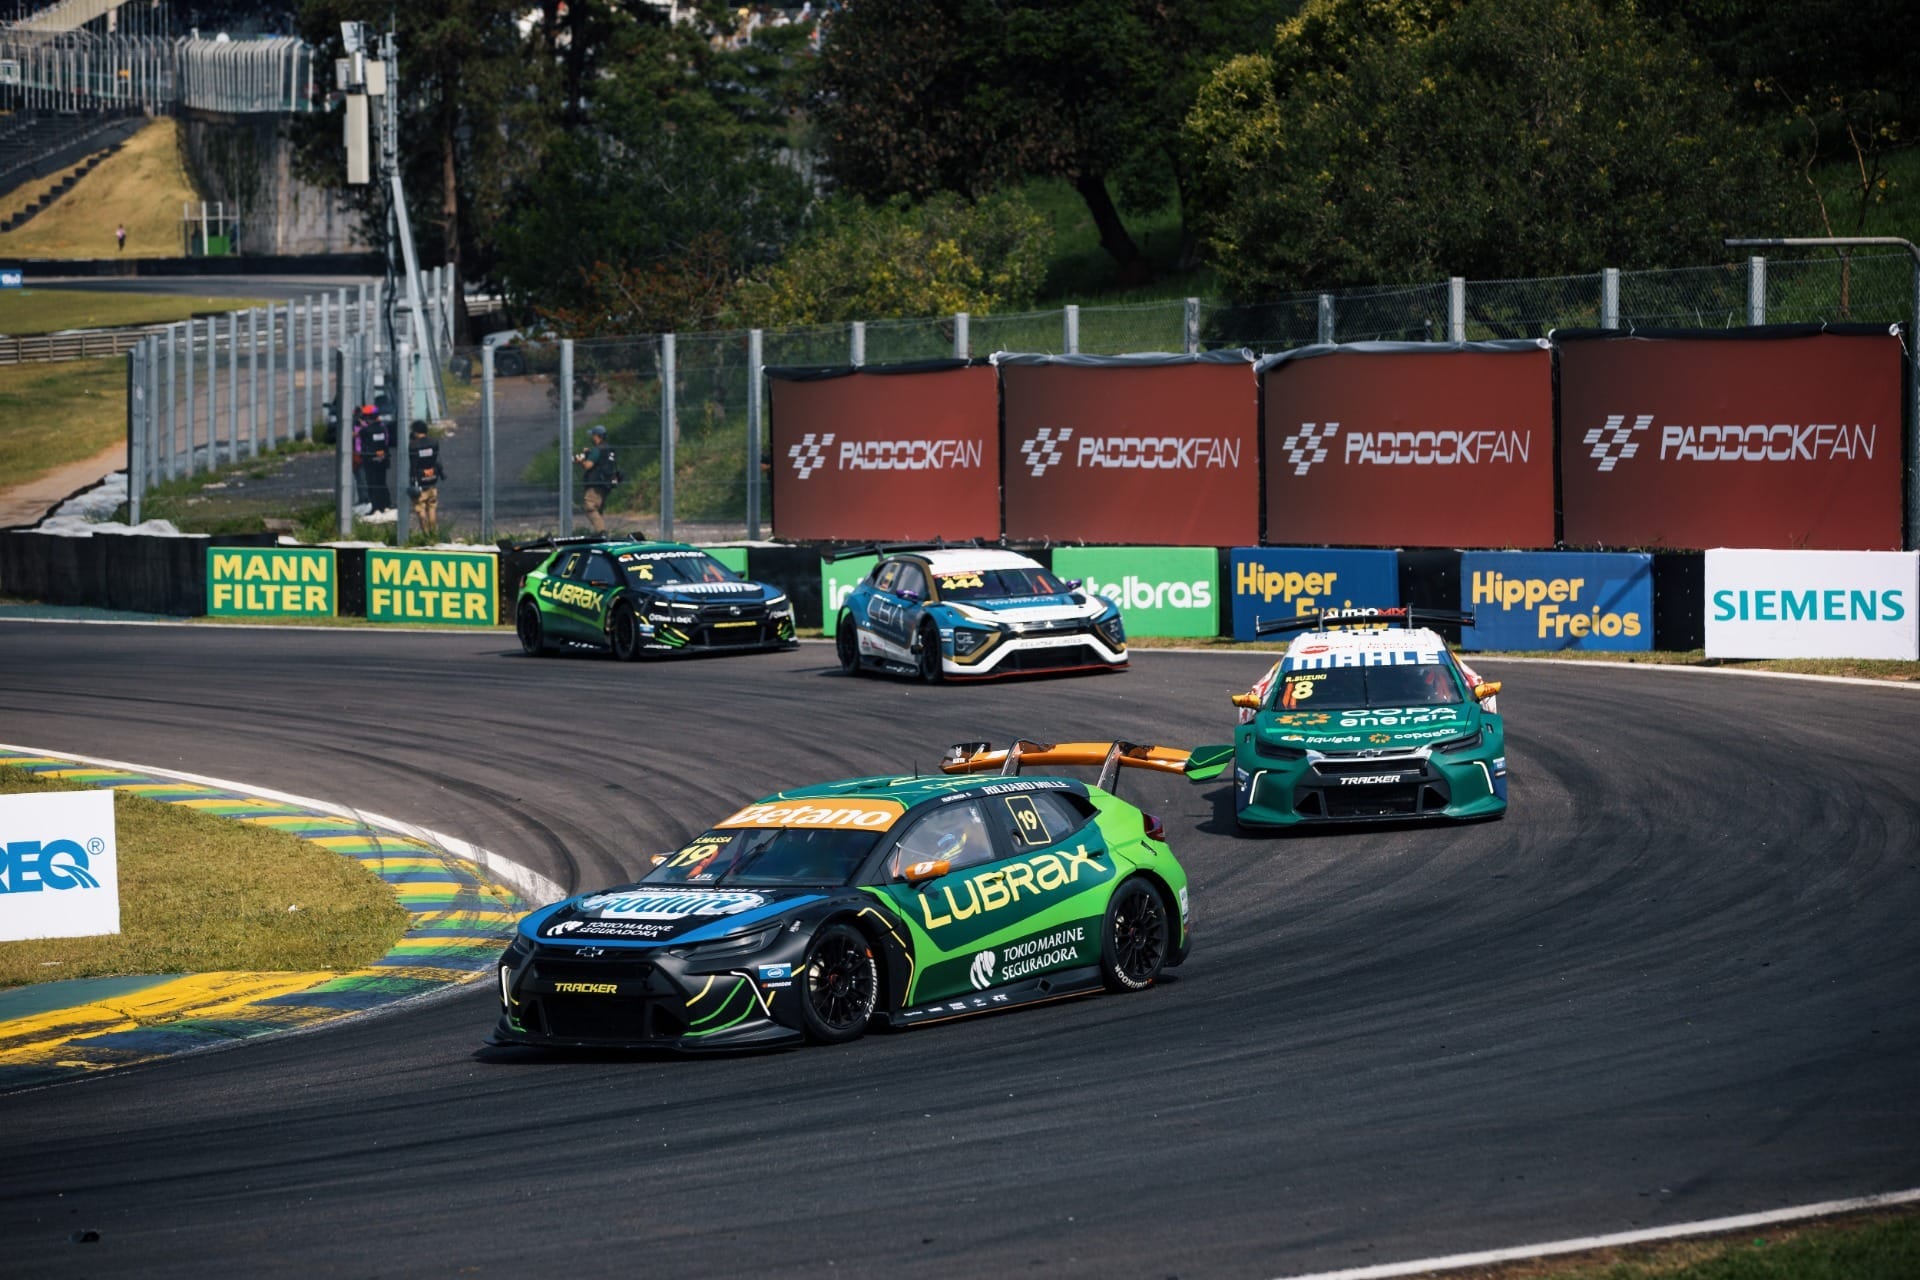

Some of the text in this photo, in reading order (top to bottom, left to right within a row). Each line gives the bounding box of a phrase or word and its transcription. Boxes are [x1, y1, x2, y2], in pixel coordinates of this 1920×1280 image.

[839, 439, 983, 470] PADDOCKFAN
[1078, 437, 1241, 469] PADDOCKFAN
[1345, 430, 1530, 465] PADDOCKFAN
[1660, 424, 1876, 461] PADDOCKFAN
[213, 554, 328, 582] MANN
[371, 558, 487, 589] MANN
[1237, 562, 1338, 603] Hipper
[213, 583, 329, 612] FILTER
[371, 588, 488, 620] FILTER
[1472, 570, 1585, 611] Hipper
[1713, 589, 1906, 622] SIEMENS
[1538, 604, 1642, 638] Freios
[1292, 650, 1440, 671] MAHLE
[1291, 680, 1314, 699] 8
[1341, 707, 1458, 719] COPA
[981, 782, 1034, 795] RICHARD
[1339, 775, 1401, 785] TRACKER
[726, 804, 892, 826] Betano
[1016, 810, 1038, 831] 19
[0, 838, 101, 894] EQ
[665, 844, 719, 867] 19
[577, 927, 662, 938] SEGURADORA
[1037, 927, 1085, 952] MARINE
[1002, 946, 1078, 981] SEGURADORA
[554, 982, 618, 994] TRACKER
